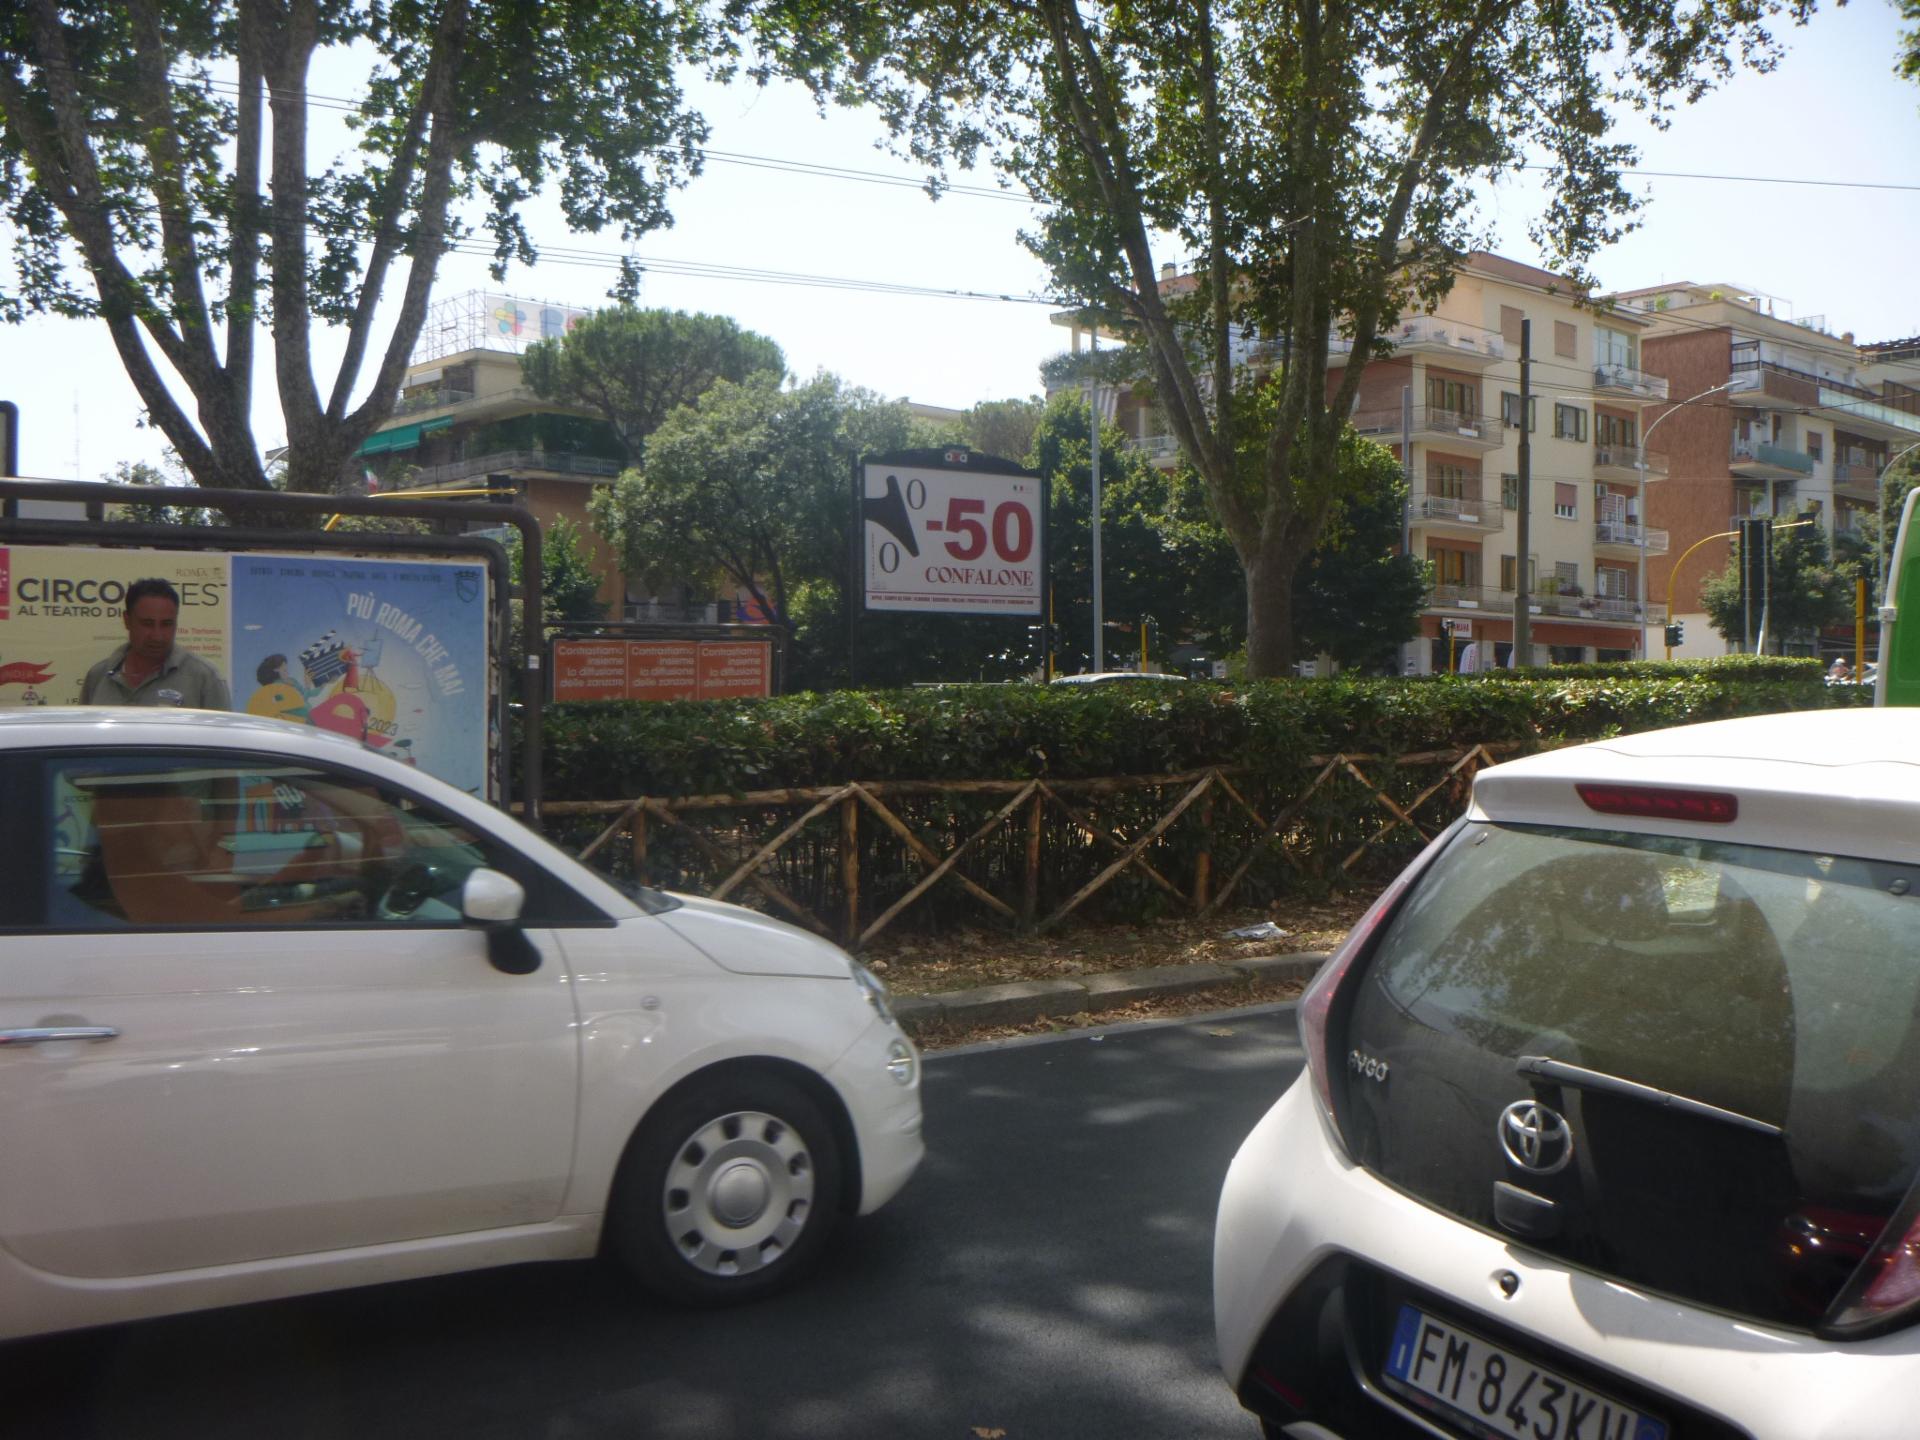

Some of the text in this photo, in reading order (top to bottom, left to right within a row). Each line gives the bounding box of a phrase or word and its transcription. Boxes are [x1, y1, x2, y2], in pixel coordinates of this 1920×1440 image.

[925, 567, 1034, 587] CONFALONE
[18, 605, 38, 616] AL
[44, 605, 102, 617] TEATRO
[347, 591, 375, 619] PIÙ
[376, 602, 423, 644] ROMA
[415, 634, 449, 668] CHE
[1347, 1049, 1388, 1082] AYGO
